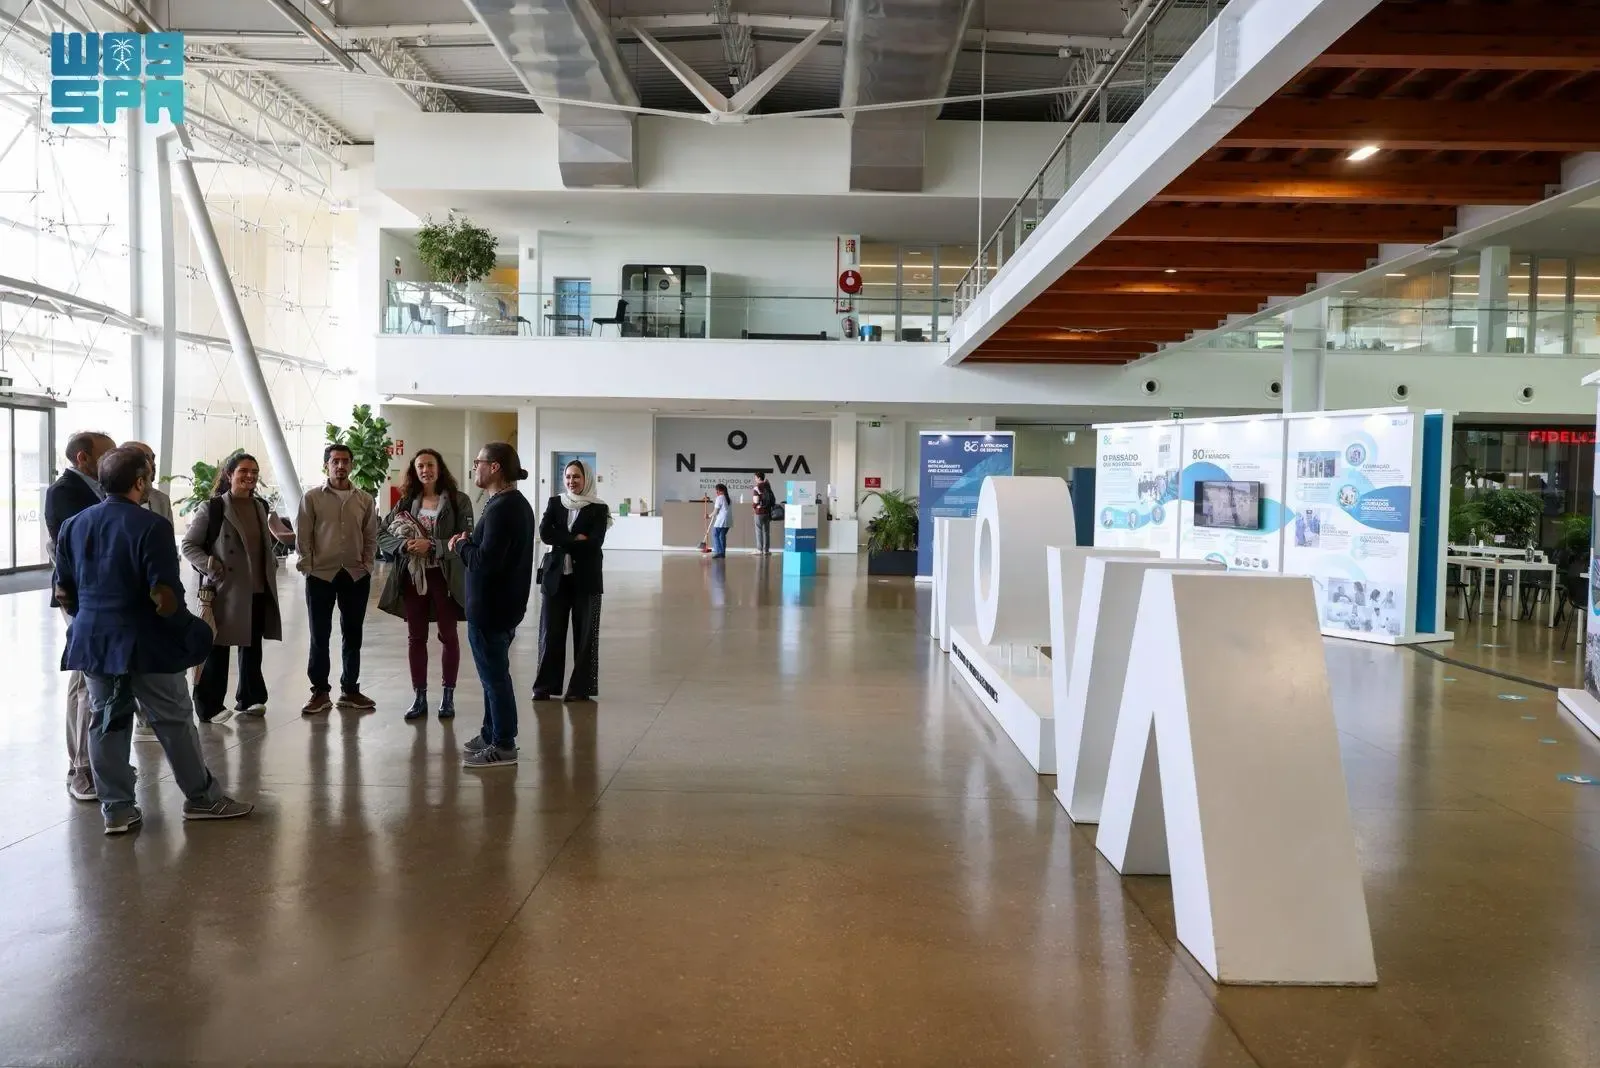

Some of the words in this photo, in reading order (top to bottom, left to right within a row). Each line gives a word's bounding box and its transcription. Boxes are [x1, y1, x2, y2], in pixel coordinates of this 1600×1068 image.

[676, 430, 811, 474] NOVA
[1102, 454, 1108, 462] O
[1108, 453, 1139, 462] PASSADO
[1191, 449, 1205, 460] 80
